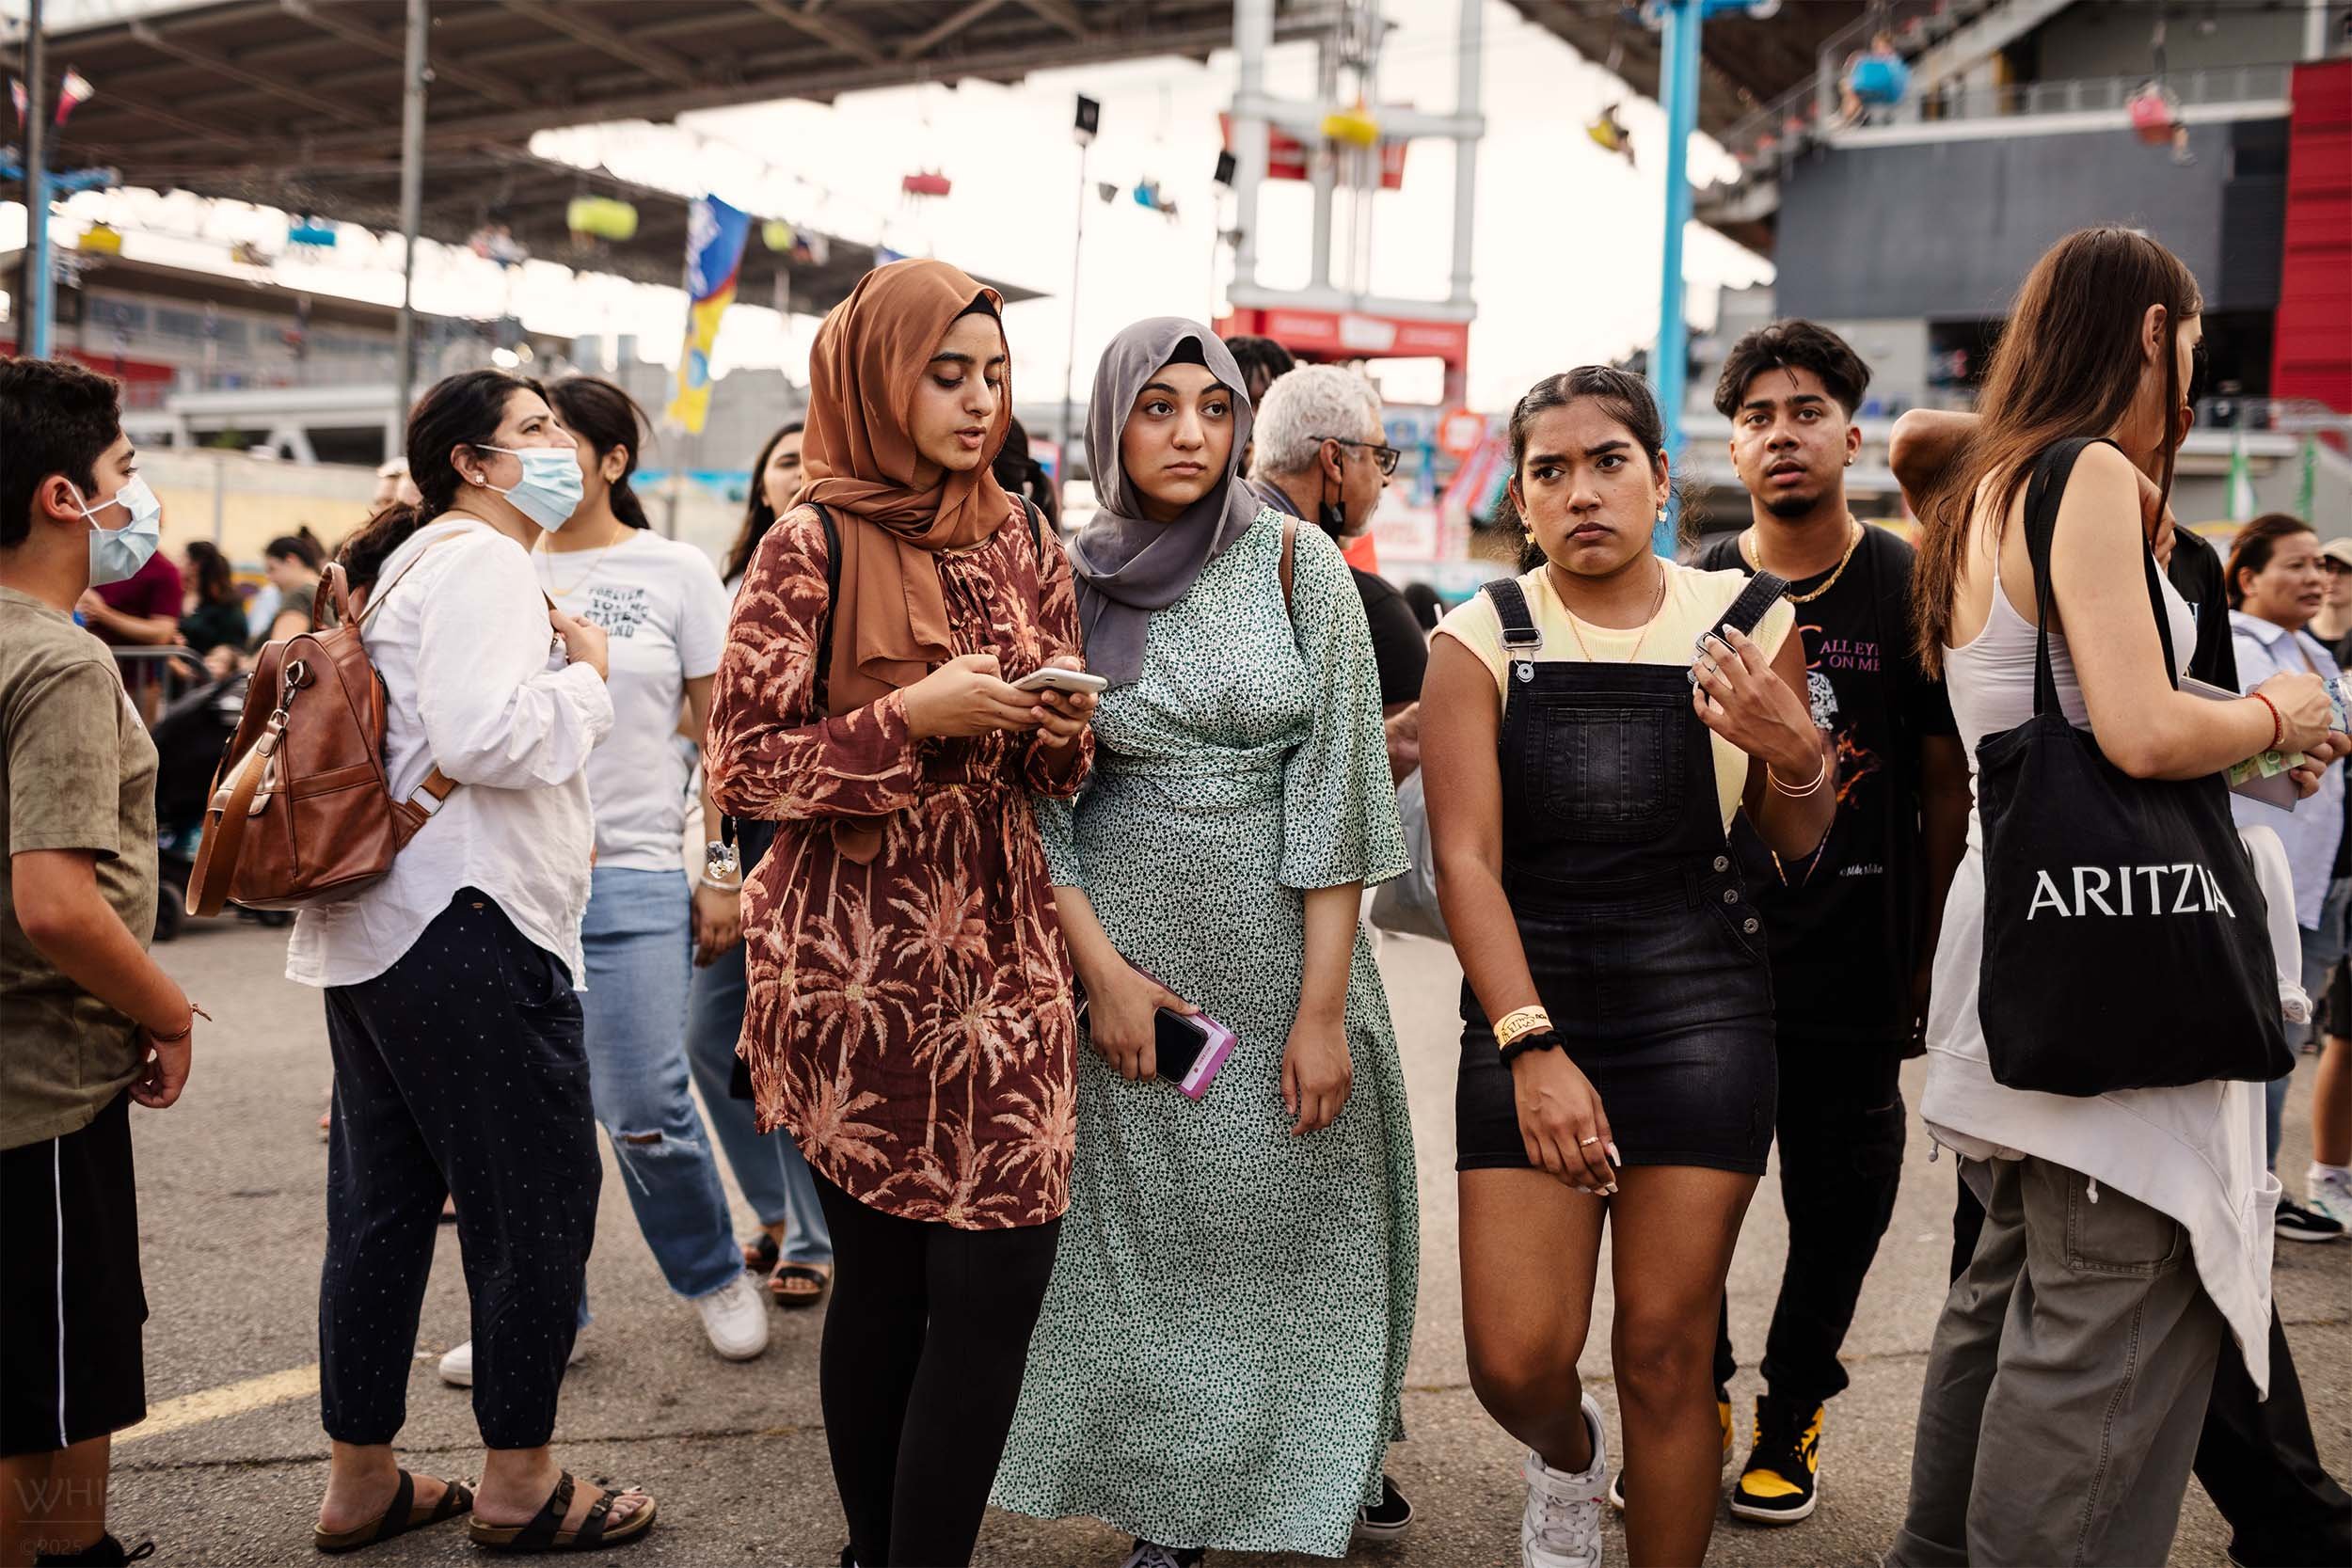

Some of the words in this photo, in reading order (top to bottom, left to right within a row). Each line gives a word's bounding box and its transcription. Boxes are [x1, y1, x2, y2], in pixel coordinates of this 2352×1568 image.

[1819, 639, 1851, 655] ALL
[1828, 654, 1854, 669] ON
[2026, 863, 2236, 921] ARITZIA
